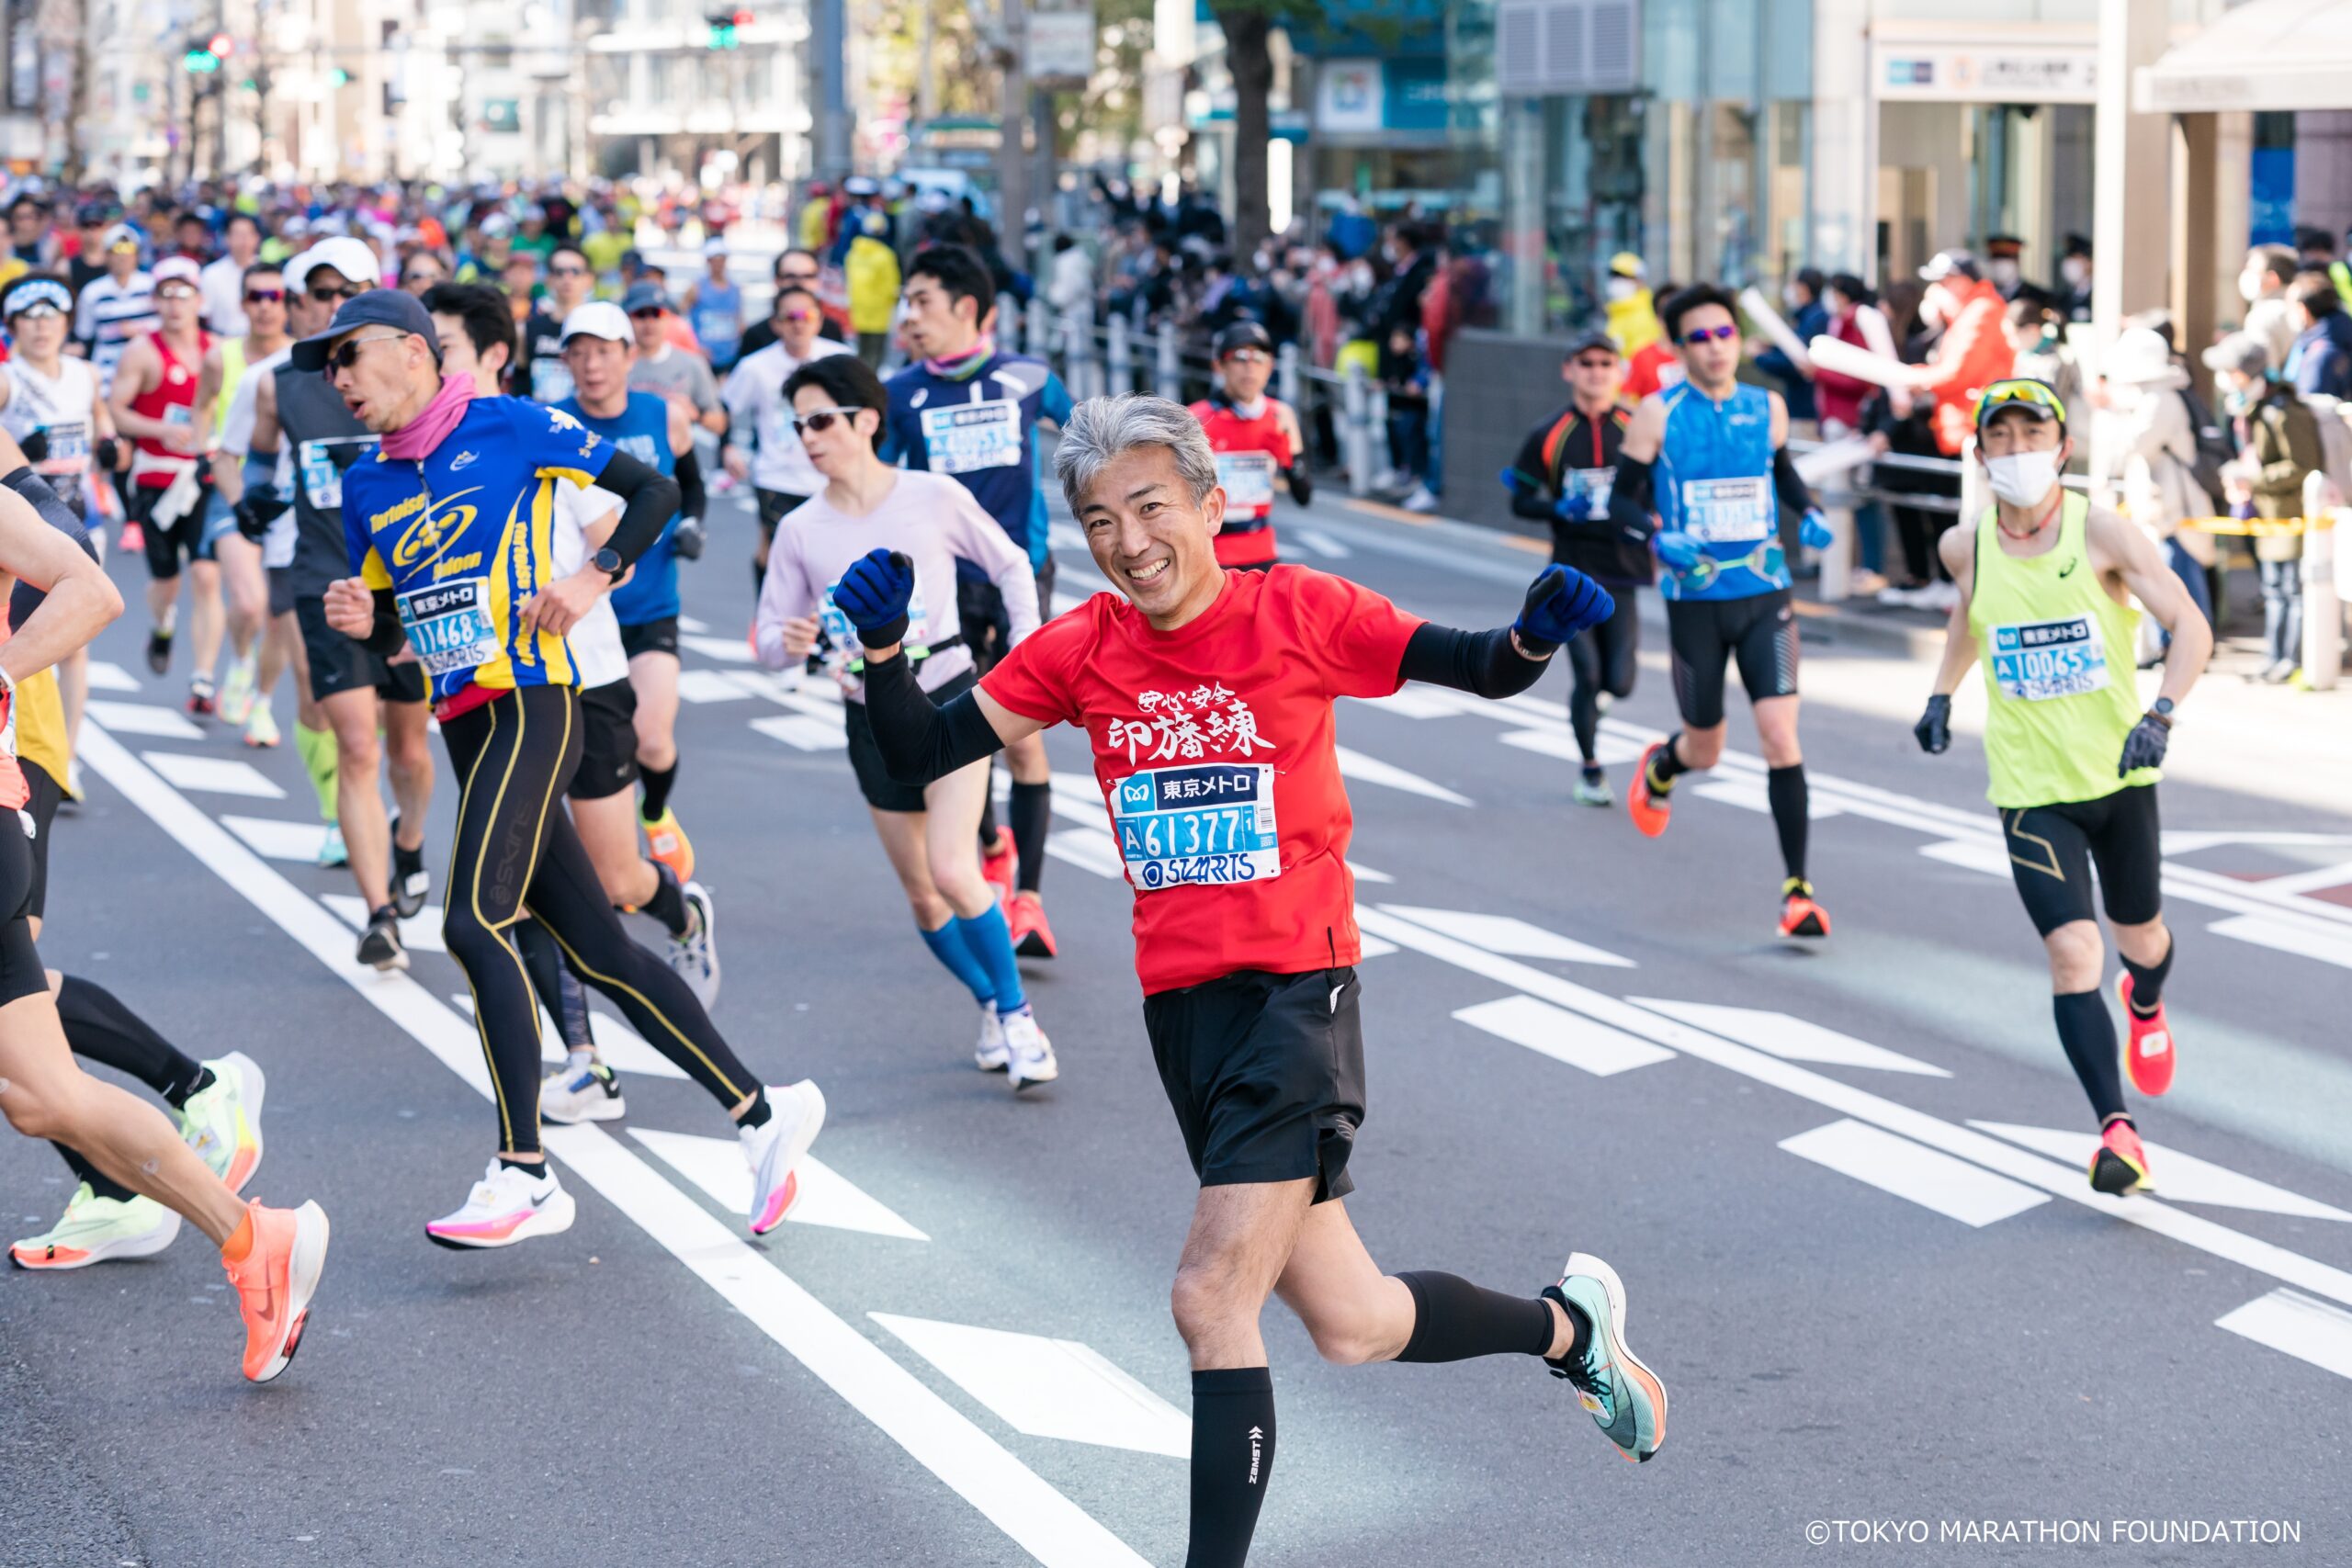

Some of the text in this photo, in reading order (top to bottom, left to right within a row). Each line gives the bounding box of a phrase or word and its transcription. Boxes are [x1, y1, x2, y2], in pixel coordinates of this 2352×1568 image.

[413, 586, 474, 616] 東京メトロ
[414, 613, 475, 655] 11468
[1997, 647, 2084, 681] A 10065
[1162, 774, 1251, 800] 東京メトロ
[1125, 809, 1252, 857] A 61377 1
